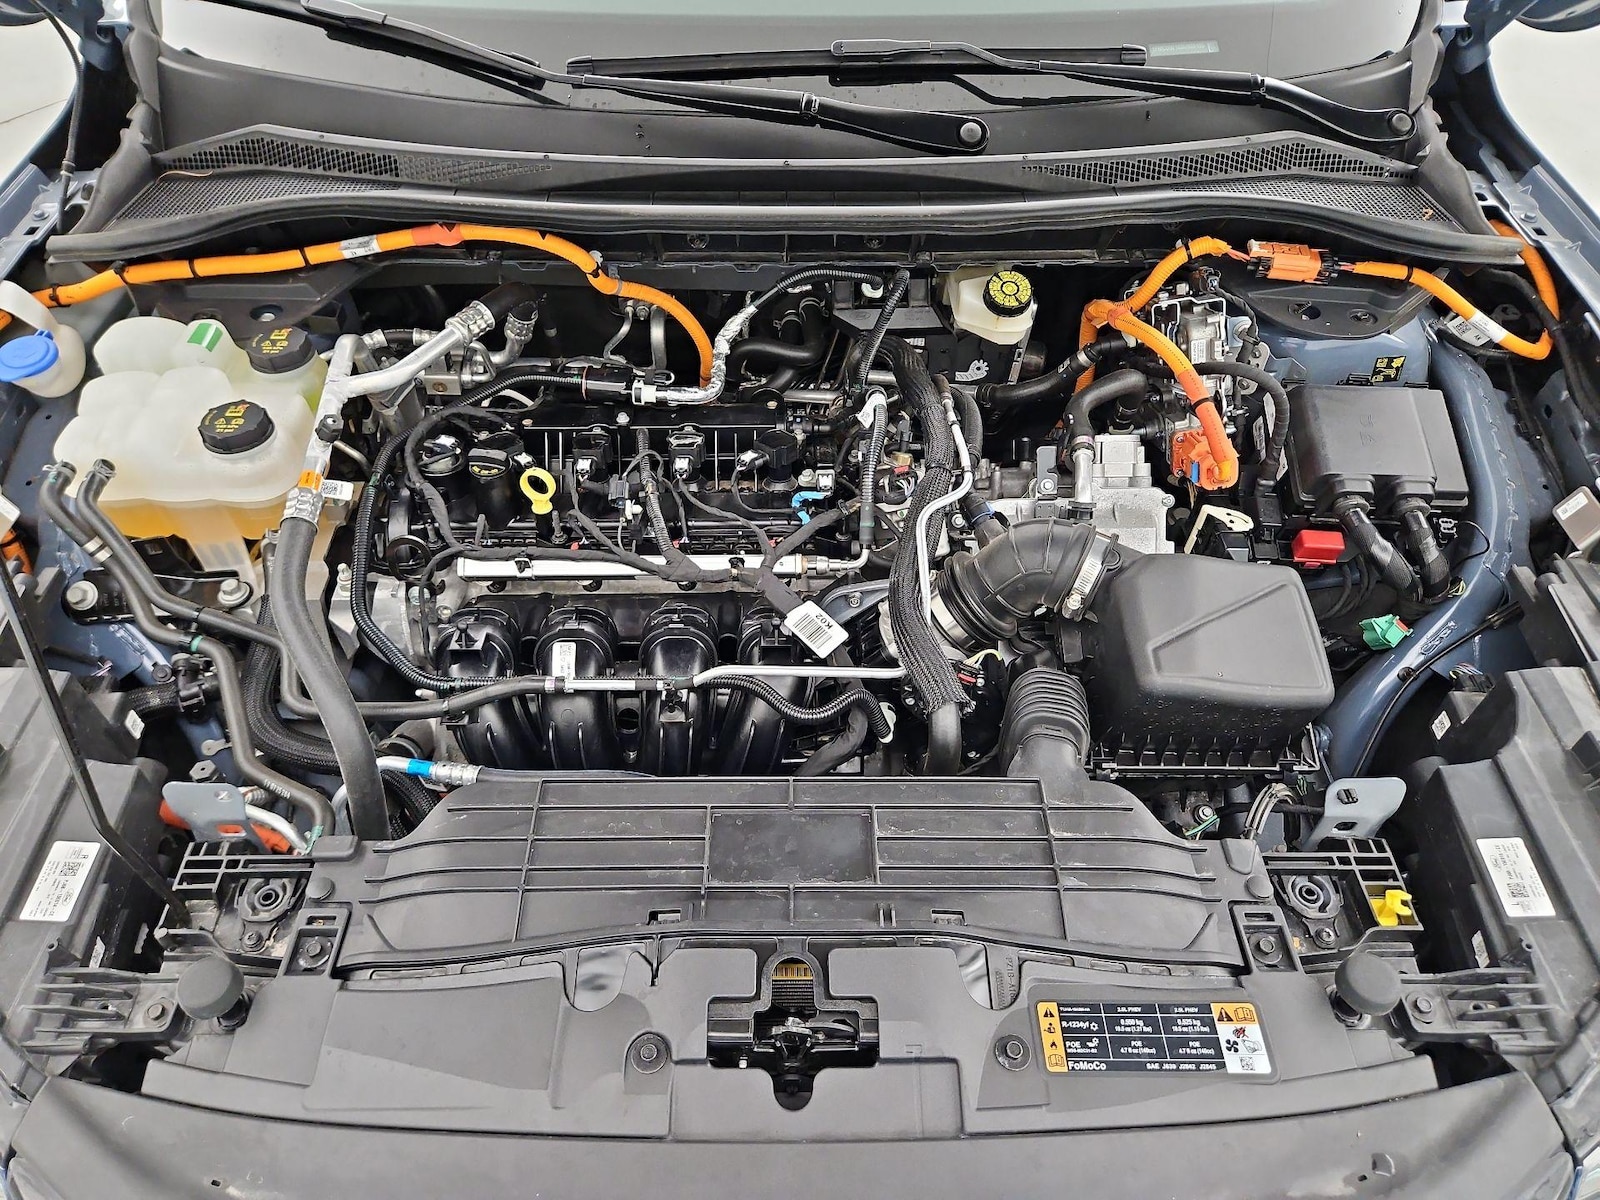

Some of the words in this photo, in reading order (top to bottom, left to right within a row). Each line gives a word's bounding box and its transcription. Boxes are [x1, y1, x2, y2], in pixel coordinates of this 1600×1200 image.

[816, 613, 833, 630] K02
[1061, 1020, 1090, 1030] R-1234yf
[1135, 1018, 1144, 1026] kg
[1192, 1018, 1201, 1026] kg
[1068, 1061, 1107, 1070] FoMoCo
